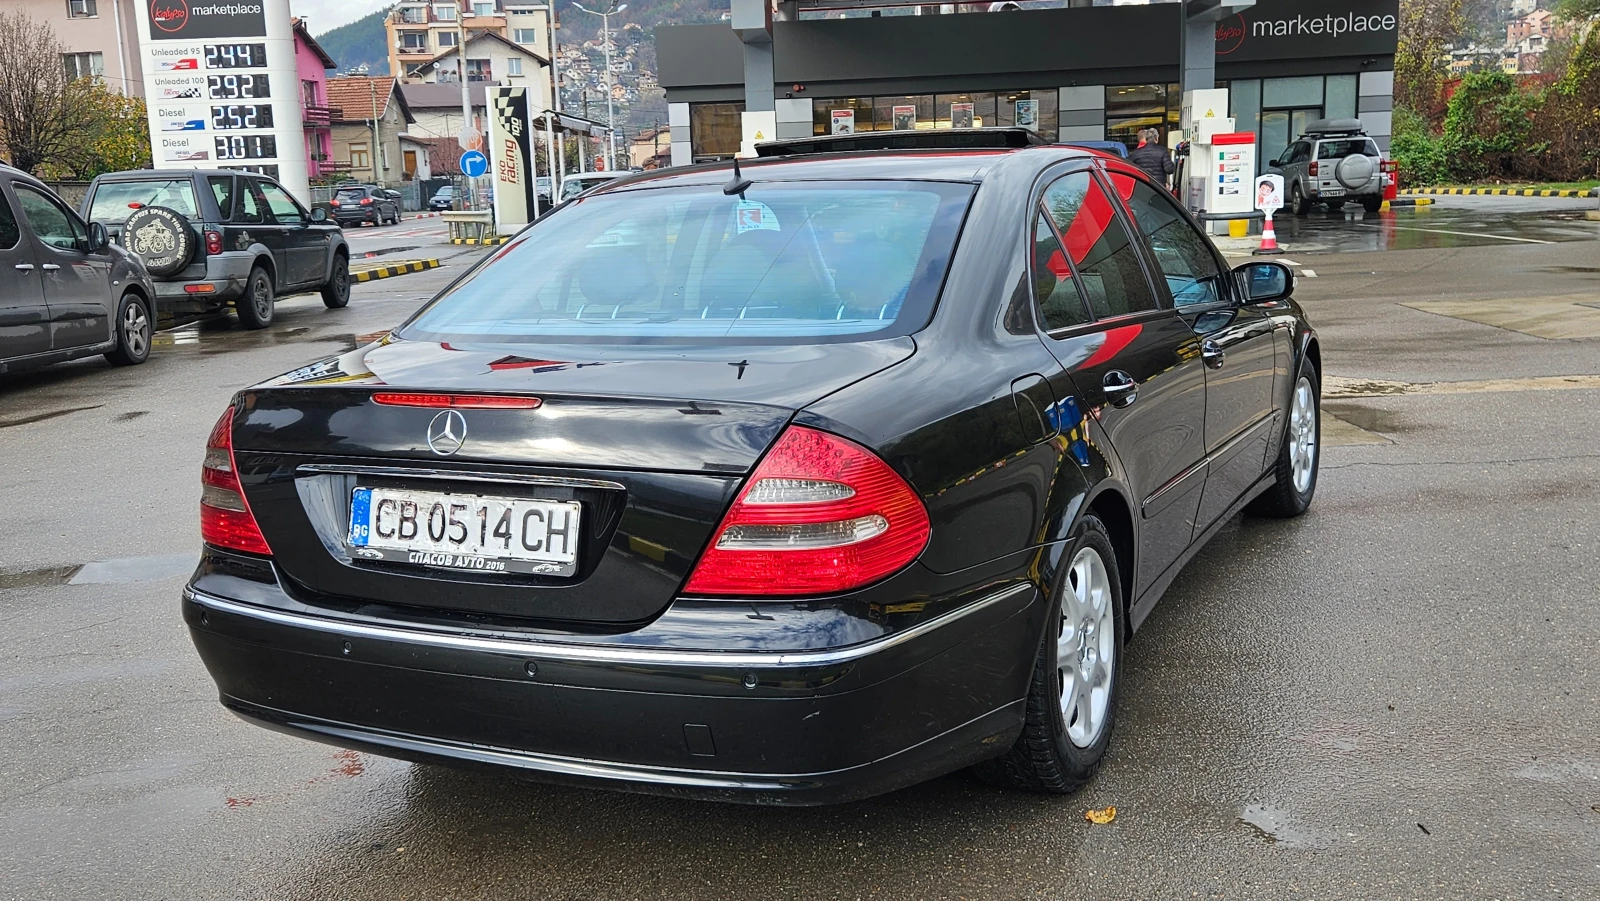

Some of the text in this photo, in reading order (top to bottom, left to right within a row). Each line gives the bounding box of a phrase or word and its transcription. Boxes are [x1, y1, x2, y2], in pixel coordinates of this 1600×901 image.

[192, 3, 261, 17] marketplace
[1215, 11, 1396, 41] alypso marketplace
[151, 47, 201, 57] Unleaded 95
[205, 45, 251, 68] 2.44
[154, 77, 190, 86] Unleaded
[208, 74, 254, 99] 2.92
[158, 107, 186, 117] Diesel
[212, 105, 257, 129] 2.52
[510, 116, 521, 137] 100
[162, 138, 189, 147] Diesel
[216, 135, 262, 159] 3.01
[499, 160, 507, 182] EKO
[505, 138, 517, 185] racing
[149, 209, 173, 220] SPARE
[171, 217, 184, 233] TIRE
[176, 233, 186, 260] COVERS
[353, 523, 368, 539] BG
[427, 503, 512, 550] 0514
[521, 508, 570, 554] CH
[408, 551, 505, 571] СПАСОВ АУТО 2016
